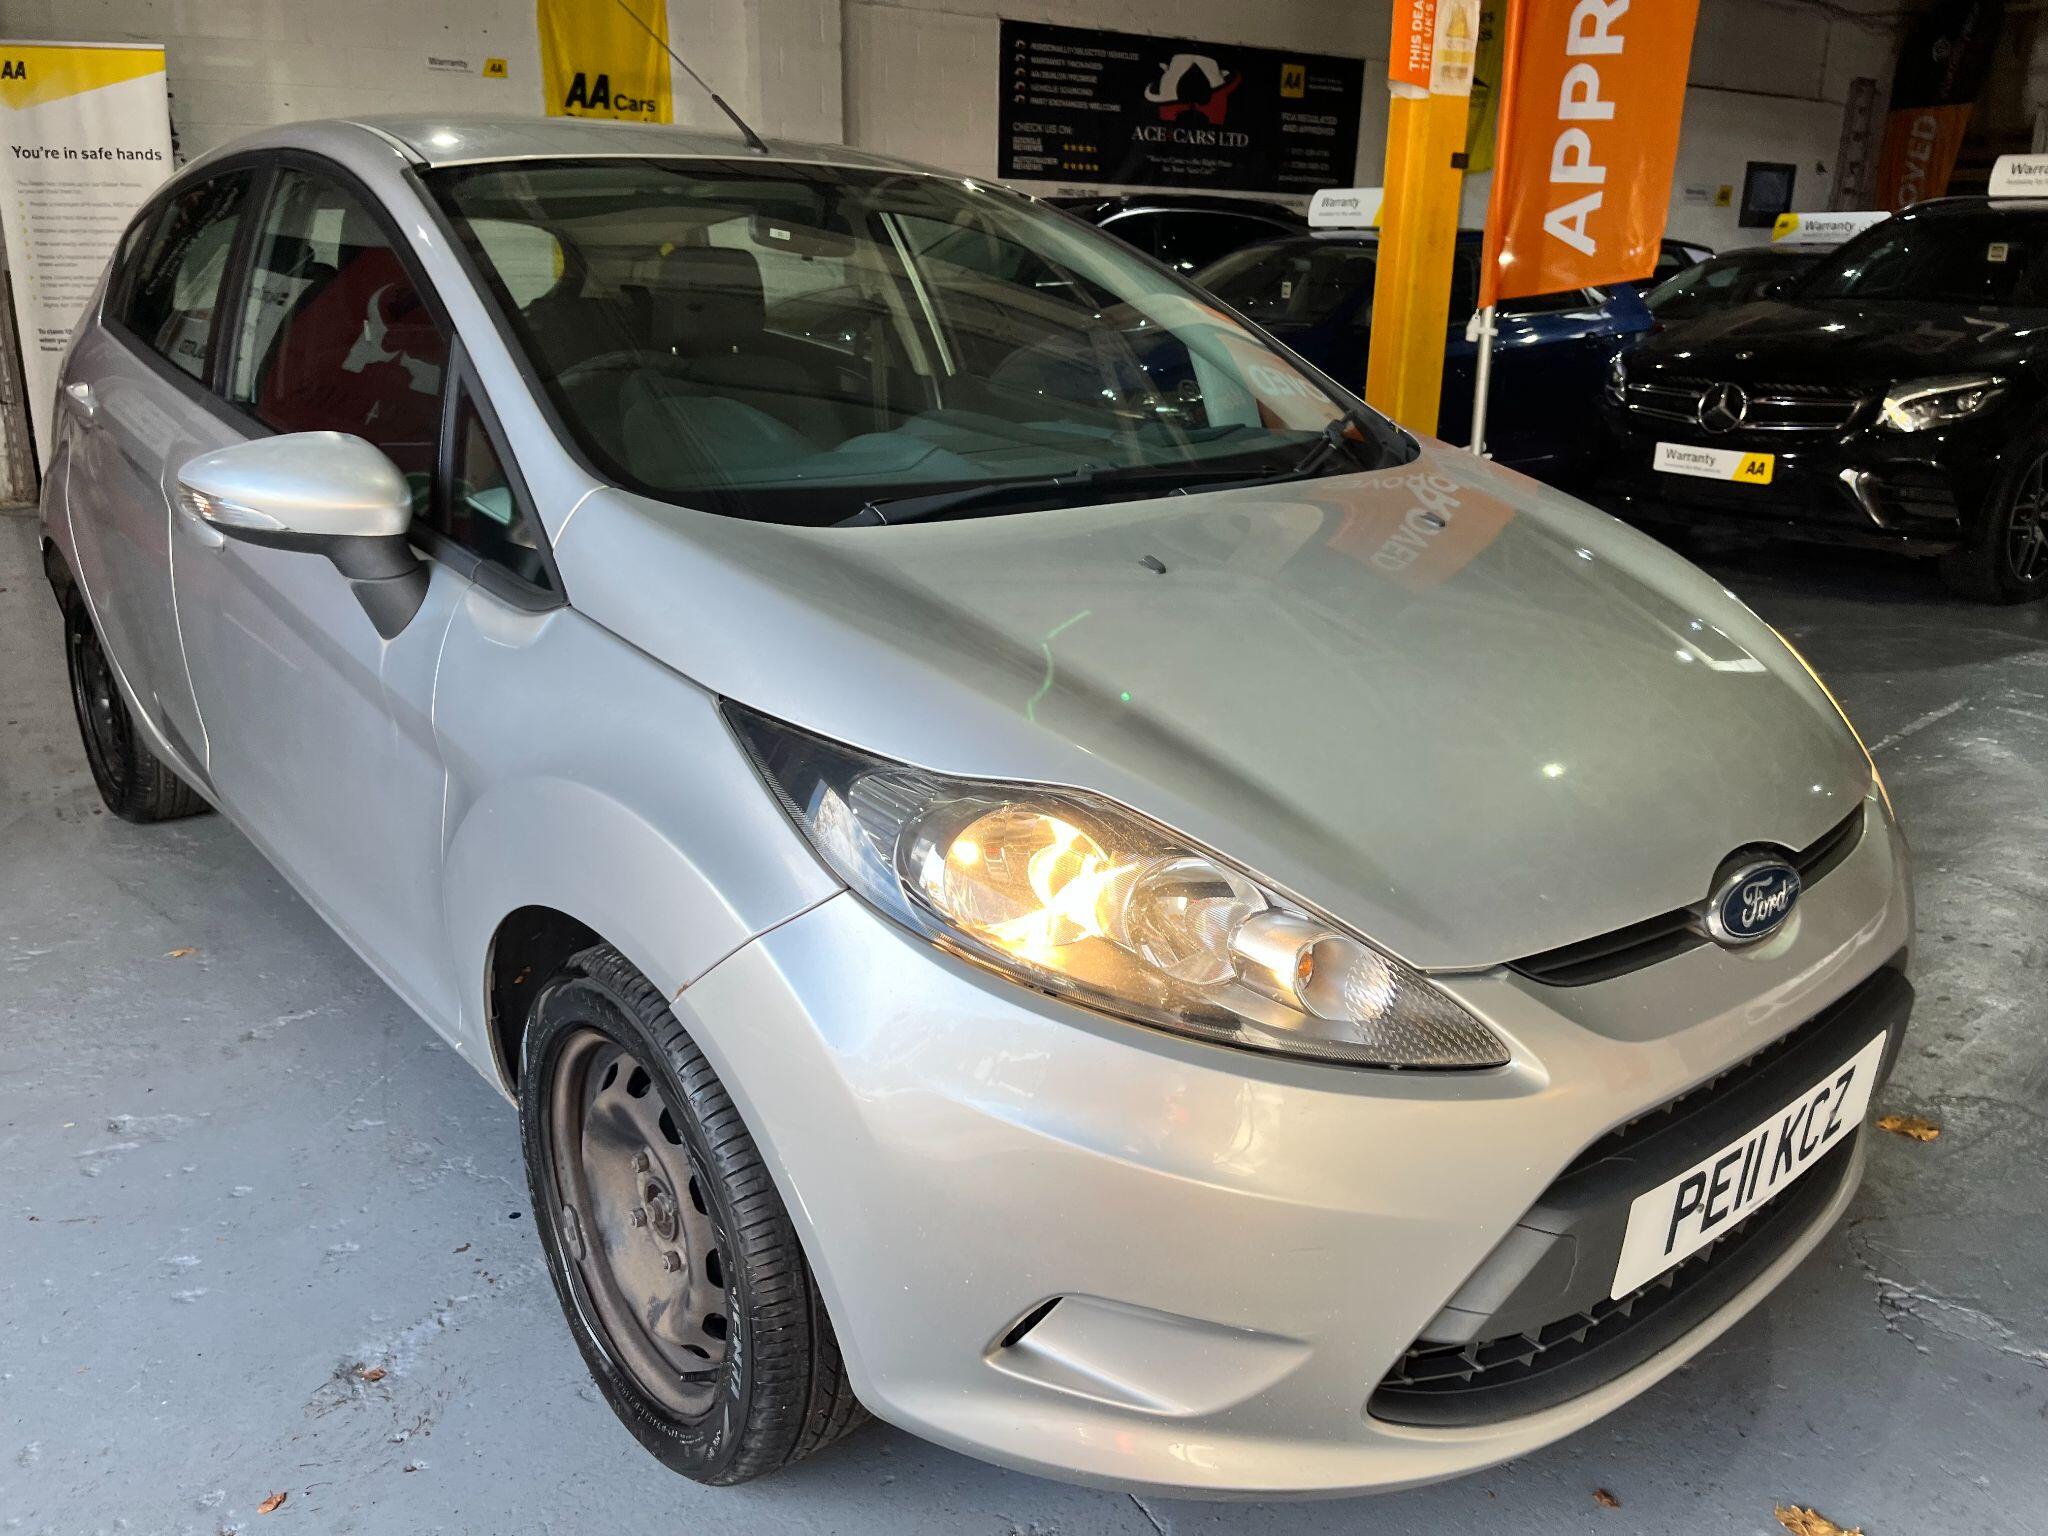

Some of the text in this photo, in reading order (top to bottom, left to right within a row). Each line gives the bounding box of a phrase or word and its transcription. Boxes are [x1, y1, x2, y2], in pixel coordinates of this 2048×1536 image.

[1408, 34, 1422, 73] THIS
[1421, 2, 1434, 73] THE UK'S
[1, 60, 27, 80] AA
[564, 72, 656, 113] AA Cars
[1130, 124, 1250, 147] ACE CARS LTD
[1543, 0, 1632, 257] APPR
[11, 145, 163, 161] You're in safe hands
[1320, 196, 1361, 209] Warranty
[1804, 219, 1853, 233] Warranty
[1665, 447, 1766, 477] Warranty AA
[1741, 876, 1788, 929] Ford
[1664, 1065, 1857, 1257] PE11 KCZ
